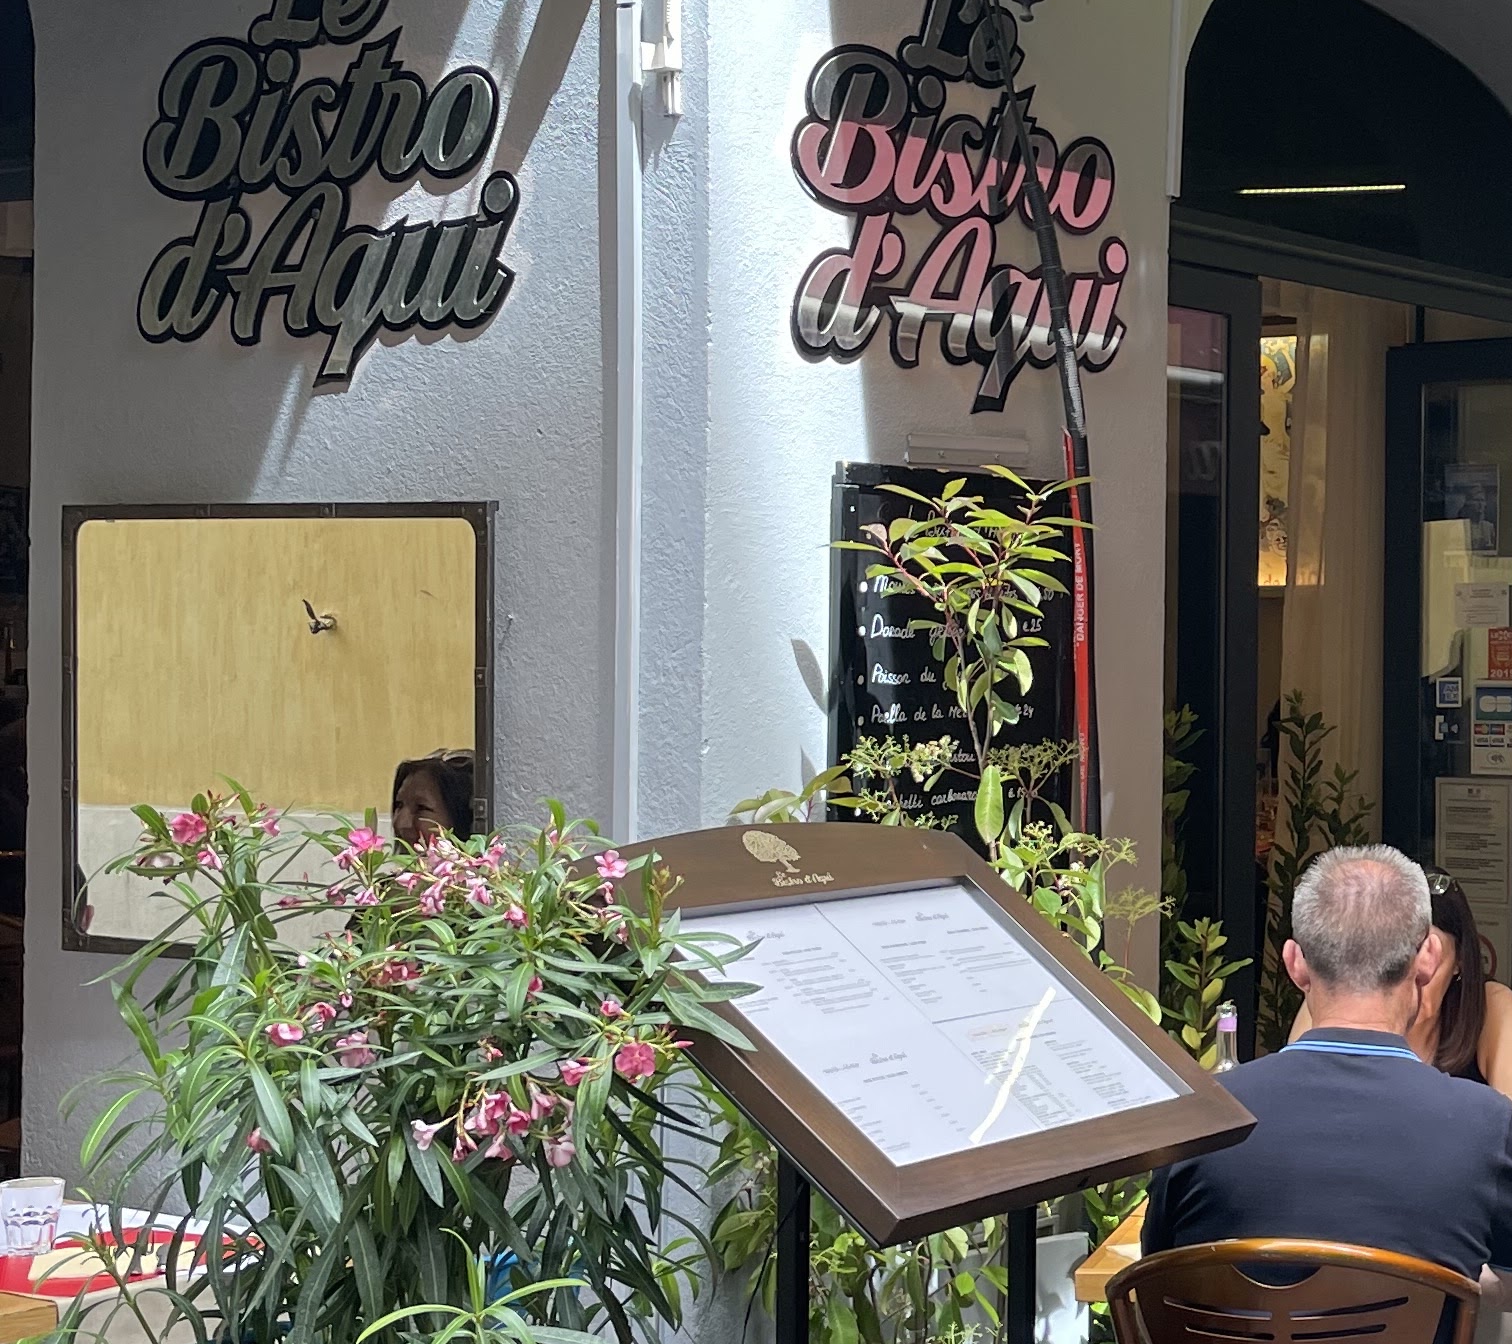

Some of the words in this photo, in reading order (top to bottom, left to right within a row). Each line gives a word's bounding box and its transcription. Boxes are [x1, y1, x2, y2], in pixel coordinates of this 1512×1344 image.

[143, 26, 498, 201] Bistro
[791, 43, 1115, 235] Bistro
[137, 170, 518, 387] d'Aqui
[790, 211, 1128, 414] d'Aqui
[871, 662, 912, 686] Poisson
[920, 666, 937, 683] du
[913, 704, 928, 722] de
[931, 703, 945, 719] la
